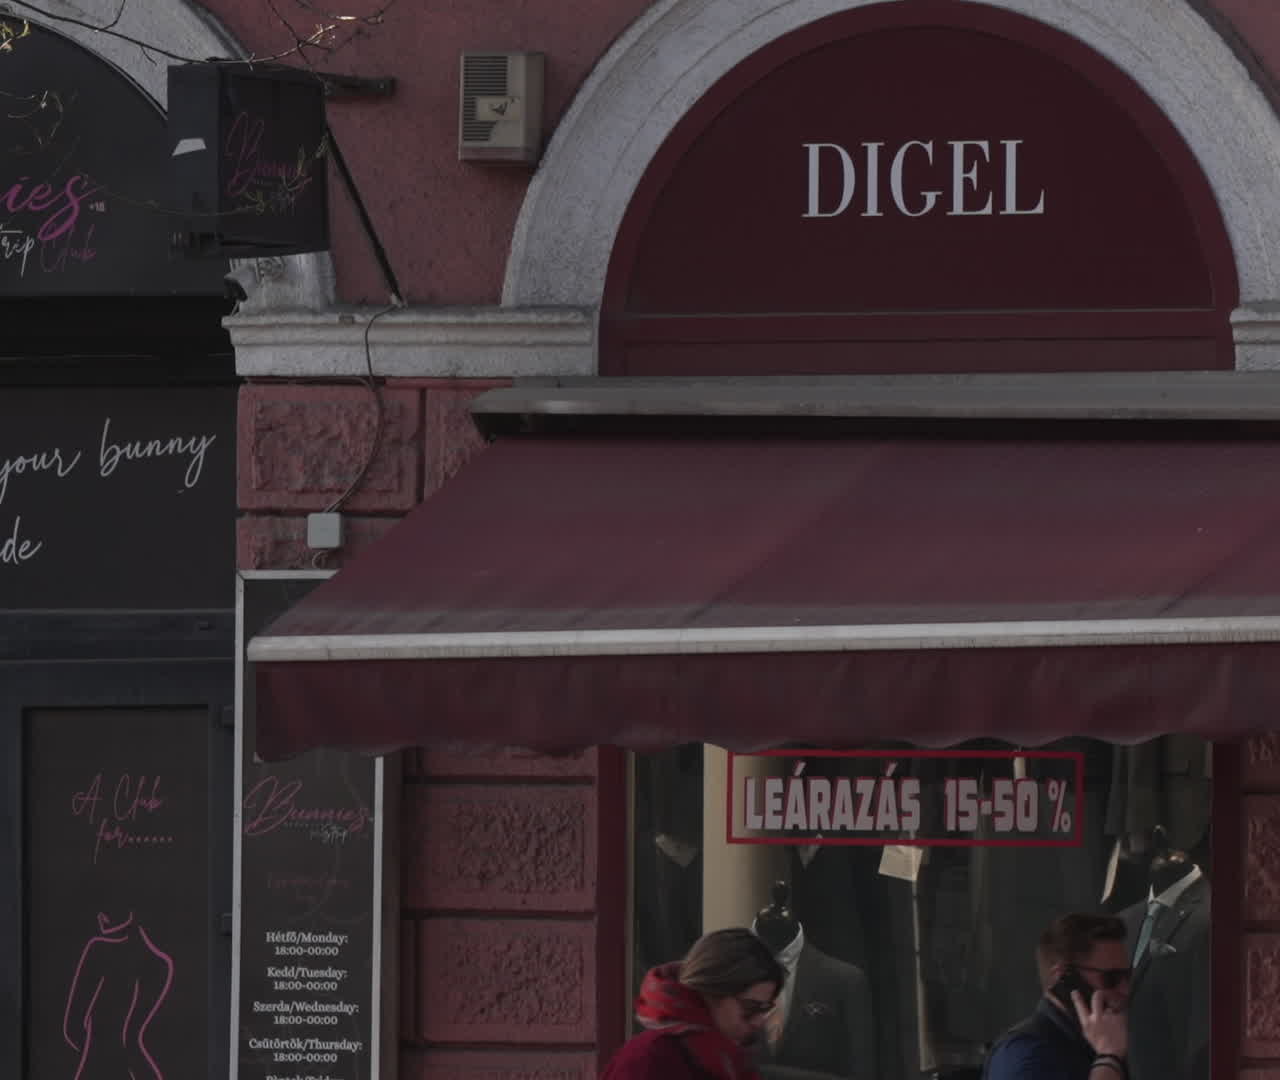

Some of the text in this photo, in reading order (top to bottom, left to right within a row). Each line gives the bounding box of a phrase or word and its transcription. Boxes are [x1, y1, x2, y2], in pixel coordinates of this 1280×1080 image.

[801, 139, 1045, 218] DIGEL
[0, 417, 216, 503] your bunny
[744, 760, 1071, 833] LEÁRAZÁS 15-50 %
[274, 946, 339, 956] 18:00-00:00
[273, 981, 338, 991] 18:00-00:00
[273, 1015, 338, 1025] 18:00-00:00
[272, 1053, 338, 1063] 18:00-00:00
